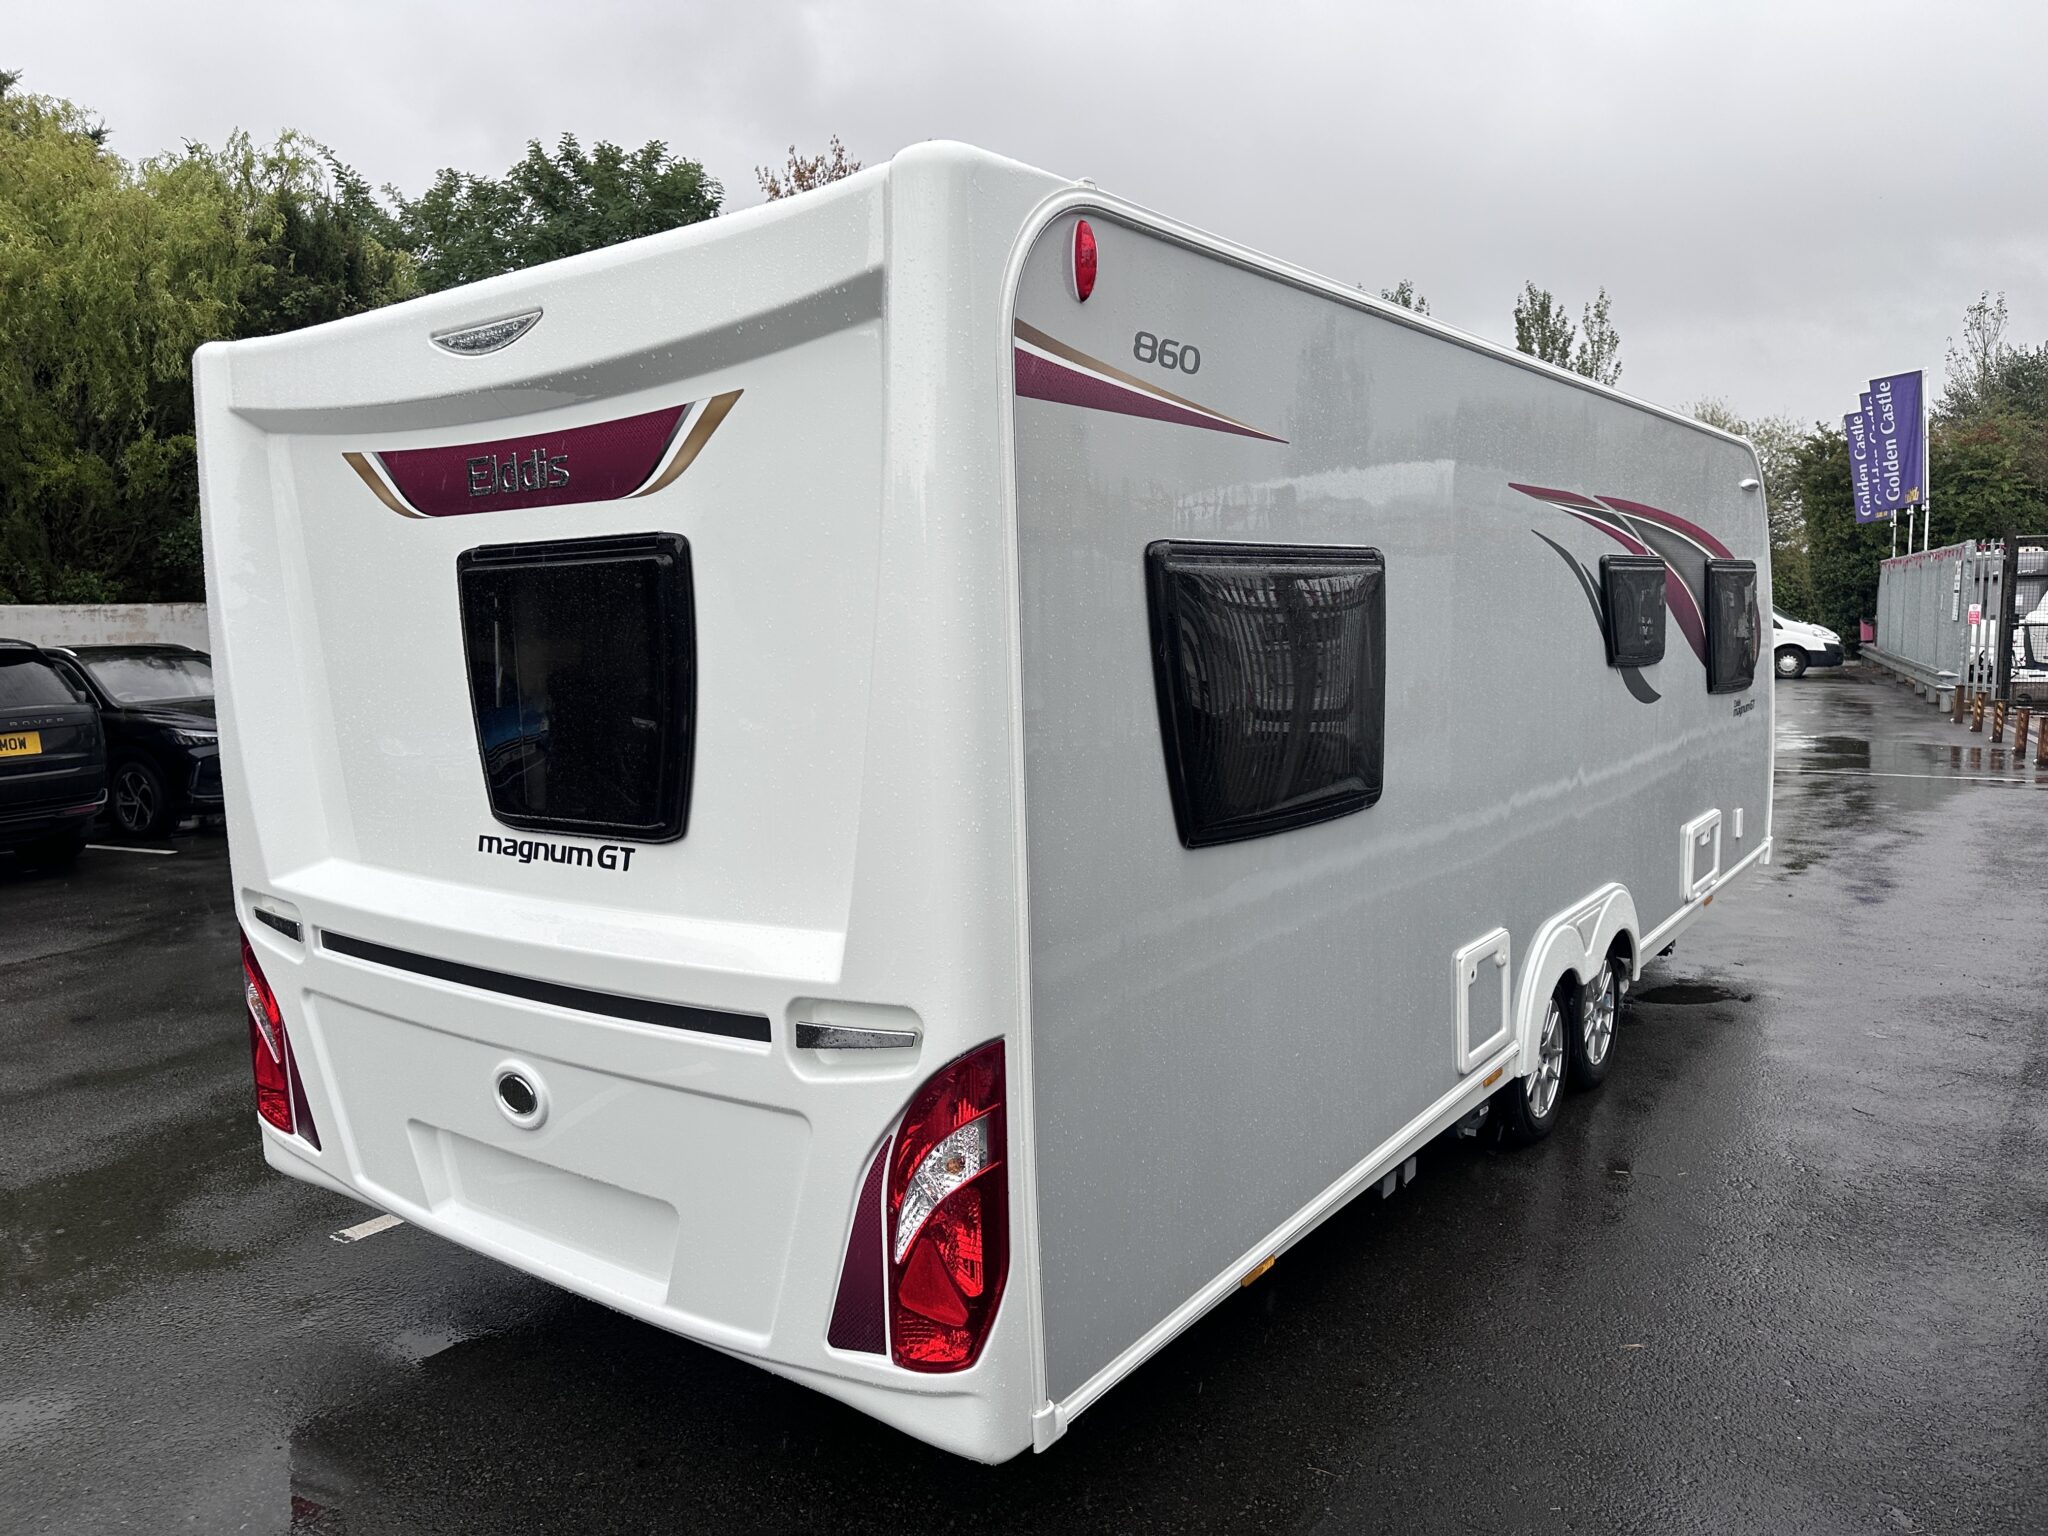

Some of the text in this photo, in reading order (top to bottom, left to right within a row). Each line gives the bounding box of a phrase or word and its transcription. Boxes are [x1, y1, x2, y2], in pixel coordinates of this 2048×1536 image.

[1133, 331, 1201, 375] 860
[1876, 381, 1900, 501] Golden Castle
[466, 448, 570, 497] Elddis
[478, 834, 636, 872] magnum GT
